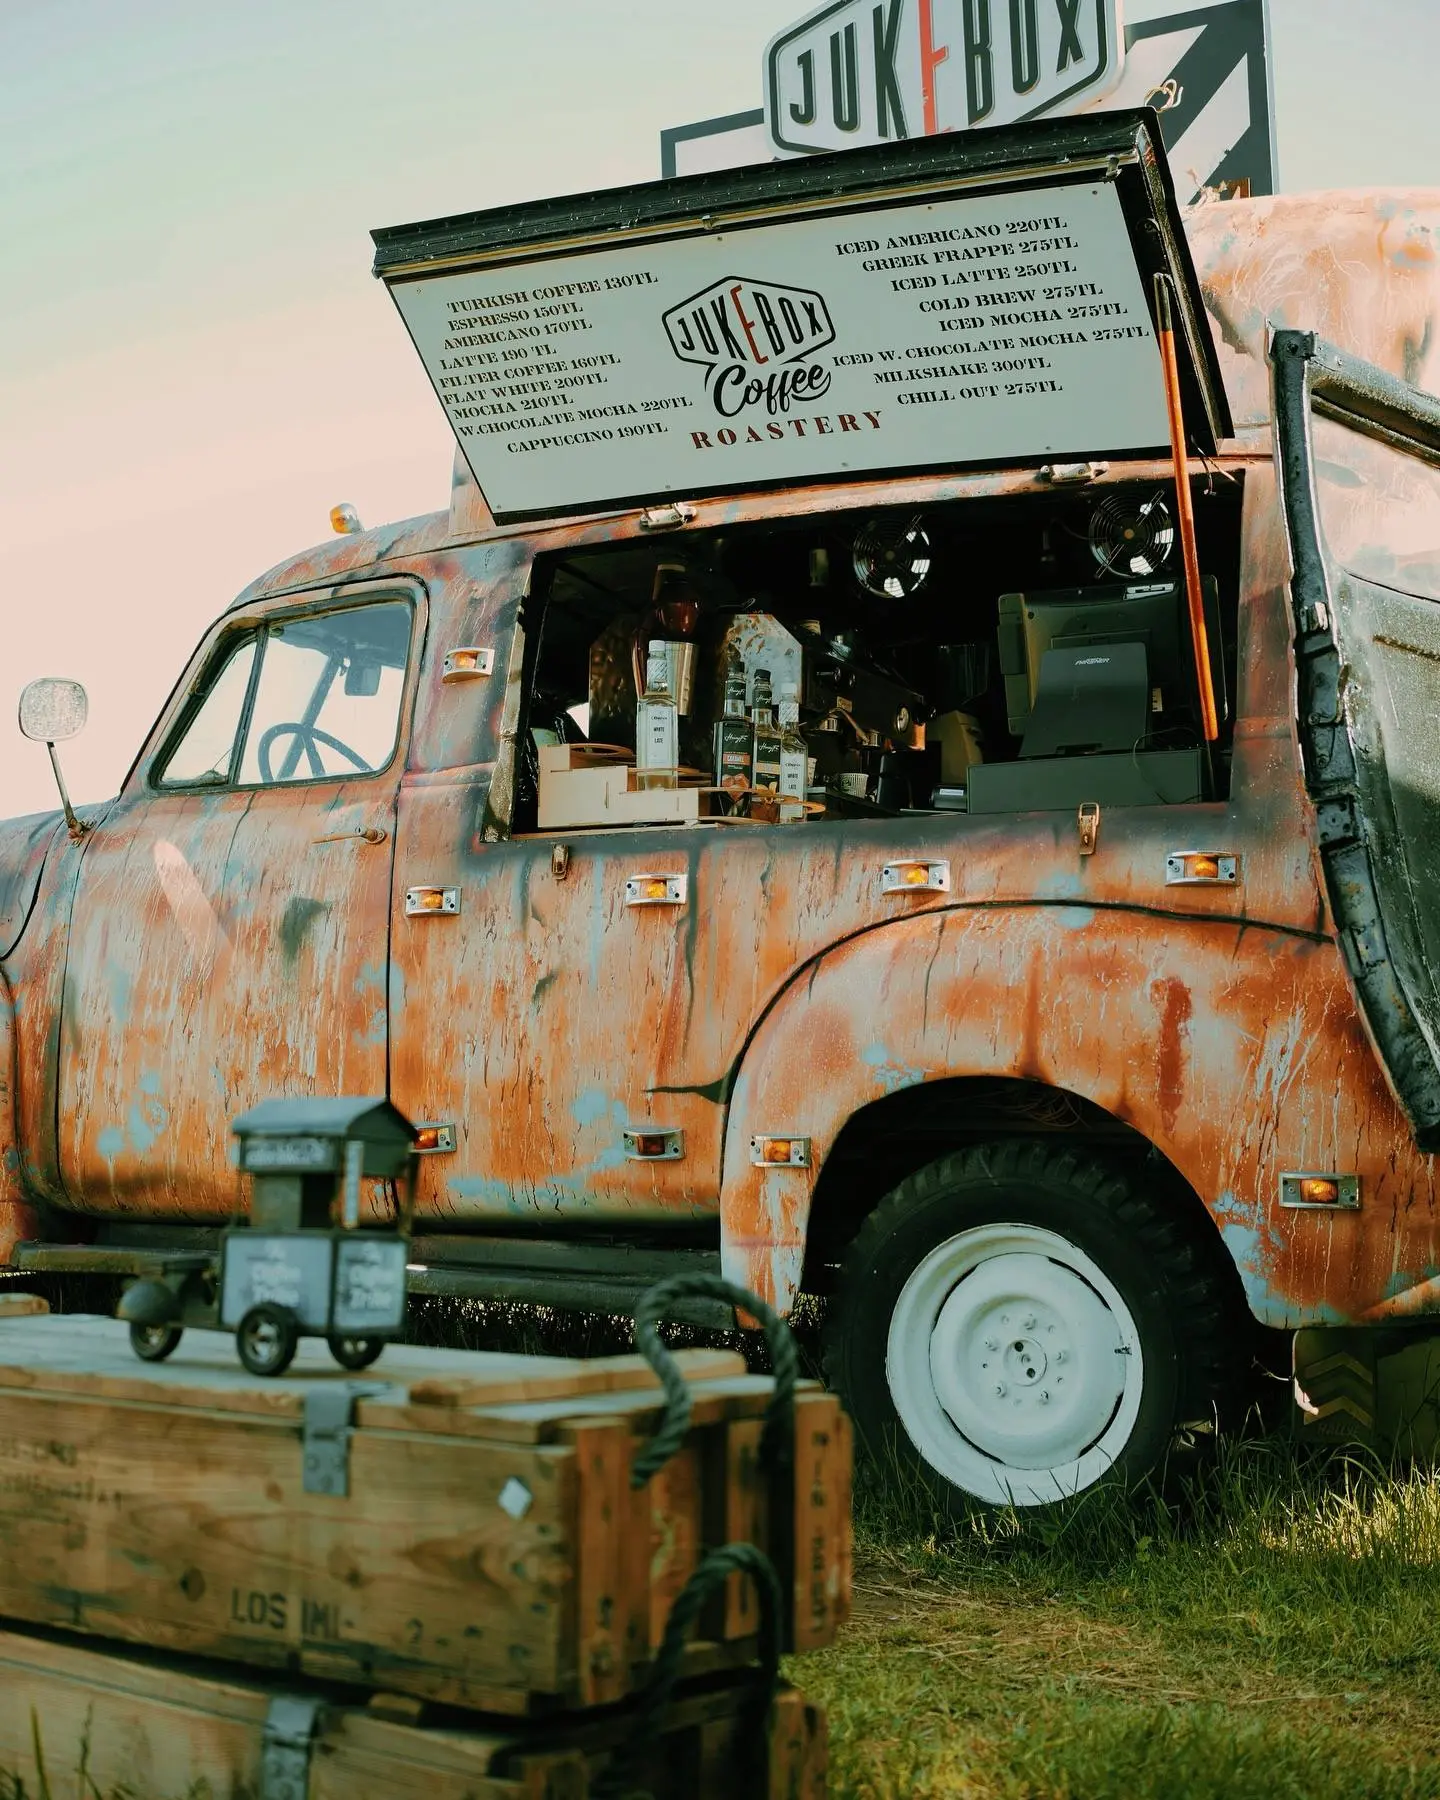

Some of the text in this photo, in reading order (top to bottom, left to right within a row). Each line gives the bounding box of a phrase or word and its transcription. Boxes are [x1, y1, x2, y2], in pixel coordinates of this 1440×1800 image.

[788, 0, 1085, 139] JUKEBOX
[835, 217, 1068, 256] ICED AMERICANO 220TL
[862, 236, 1078, 272] GREEK FRAPPE 275TL
[890, 260, 1077, 292] ICED LATTE 250TL
[446, 272, 659, 313] TURKISH COFFEE 130TL
[919, 283, 1103, 313] COLD BREW 275TL
[447, 302, 583, 331] ESPRESSO 150TL
[677, 284, 823, 365] JUKEBOX
[938, 303, 1128, 332] ICED MOCHA 275TL
[444, 319, 593, 350] AMERICANO 170TL
[832, 353, 874, 367] ICED
[905, 338, 1015, 359] CHOCOLATE
[1019, 332, 1088, 348] MOCHA
[1092, 326, 1150, 341] 275TL
[439, 344, 557, 370] LATTE 190 TL
[439, 354, 621, 388] FILTER COFFEE 160TL
[873, 357, 1051, 384] MILKSHAKE 300TL
[442, 372, 608, 405] FLAT WHITE 200TL
[713, 364, 832, 417] Coffee
[897, 380, 1063, 405] CHILL OUT 275TL
[452, 394, 574, 420] MOCHA 210TL
[577, 404, 638, 421] MOCHA
[640, 396, 693, 412] 220TL
[507, 422, 668, 453] CAPPUCCINO 190TL
[689, 410, 882, 449] ROASTERY
[231, 1588, 287, 1630] LOS
